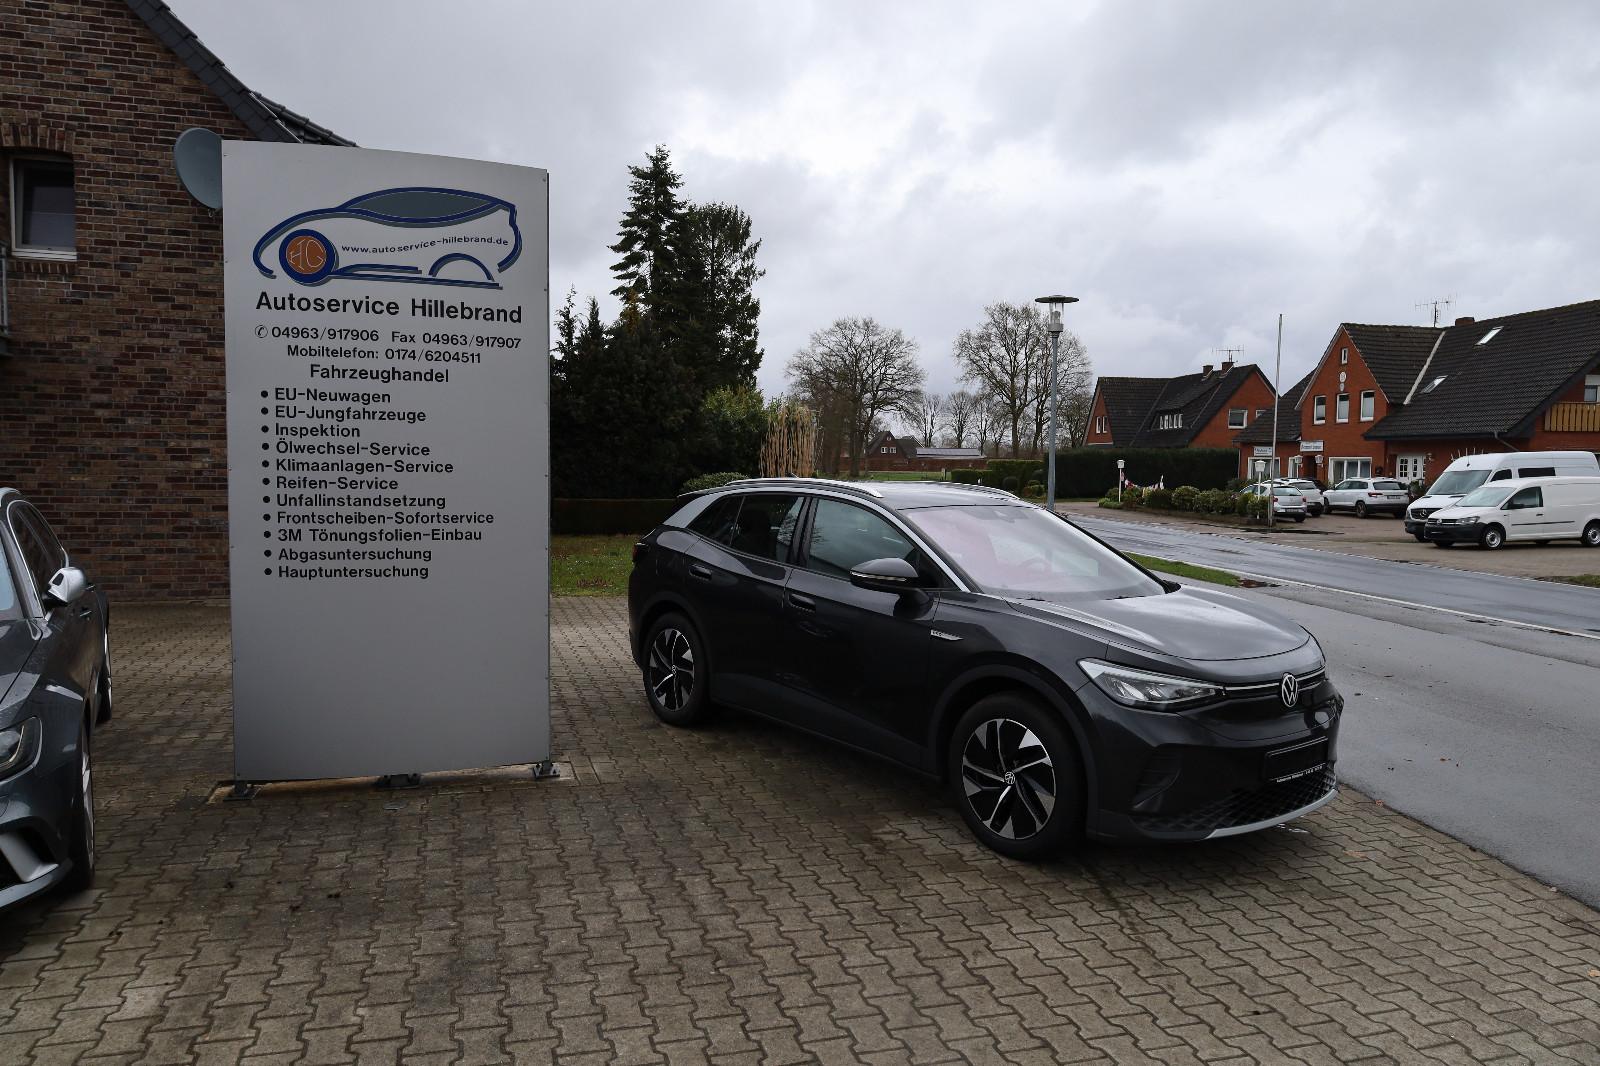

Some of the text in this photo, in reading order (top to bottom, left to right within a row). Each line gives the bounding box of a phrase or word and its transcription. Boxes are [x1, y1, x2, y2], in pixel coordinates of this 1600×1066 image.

[342, 235, 509, 254] www.autoservice-hillebrand.de
[256, 292, 521, 323] Autoservice Hillebrand
[272, 327, 521, 348] 04963/917906 Fax 04963/917907
[288, 345, 480, 363] Mobiltelefon: 0174/6204511
[311, 364, 448, 383] Fahrzeughandel
[275, 387, 391, 404] EU-Neuwagen
[275, 405, 426, 422] EU-Jungfahrzeuge
[275, 422, 361, 438] Inspektion
[276, 438, 430, 456] Ölwechsel-Service
[277, 459, 453, 474] Klimaanlagen-Service
[277, 476, 398, 489] Reifen-Service
[277, 494, 445, 509] Unfallinstandsetzung
[278, 511, 494, 524] Frontscheiben-Sofortservice
[278, 529, 481, 544] 3M Tönungsfolien-Einbau
[279, 548, 431, 563] Abgasuntersuchung
[279, 566, 428, 580] Hauptuntersuchung
